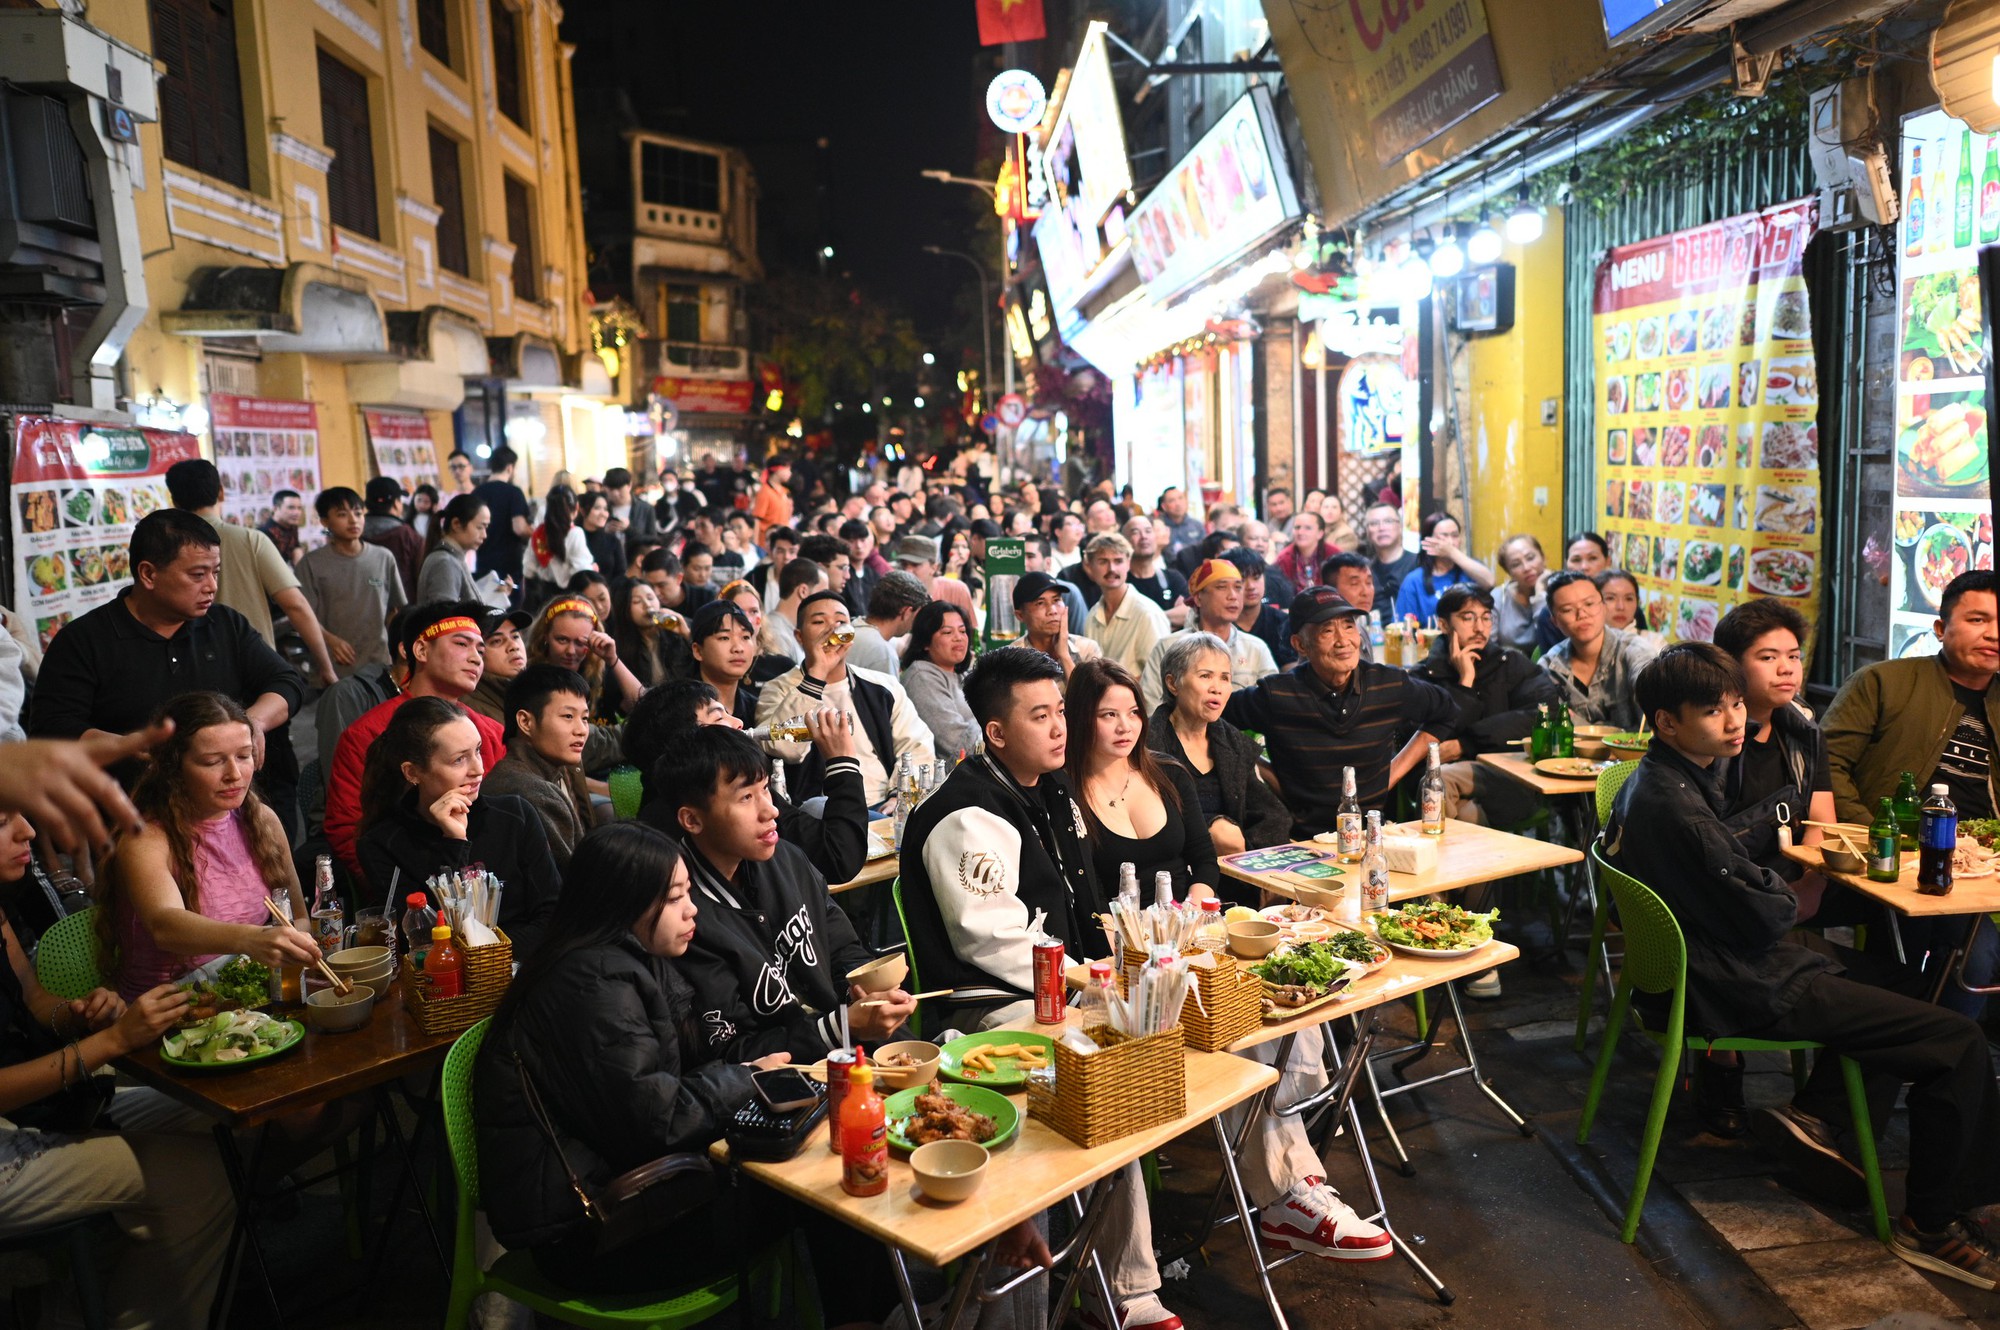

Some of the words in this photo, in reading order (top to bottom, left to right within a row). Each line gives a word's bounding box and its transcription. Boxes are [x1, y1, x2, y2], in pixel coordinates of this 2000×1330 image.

[1611, 251, 1666, 291] MENU
[1674, 228, 1725, 286] BEER
[988, 545, 1022, 559] Carlsberg
[425, 625, 439, 637] VIỆT
[439, 620, 457, 631] NAM
[1339, 831, 1359, 844] Tiger
[972, 852, 995, 884] 77
[1362, 885, 1387, 900] Tiger
